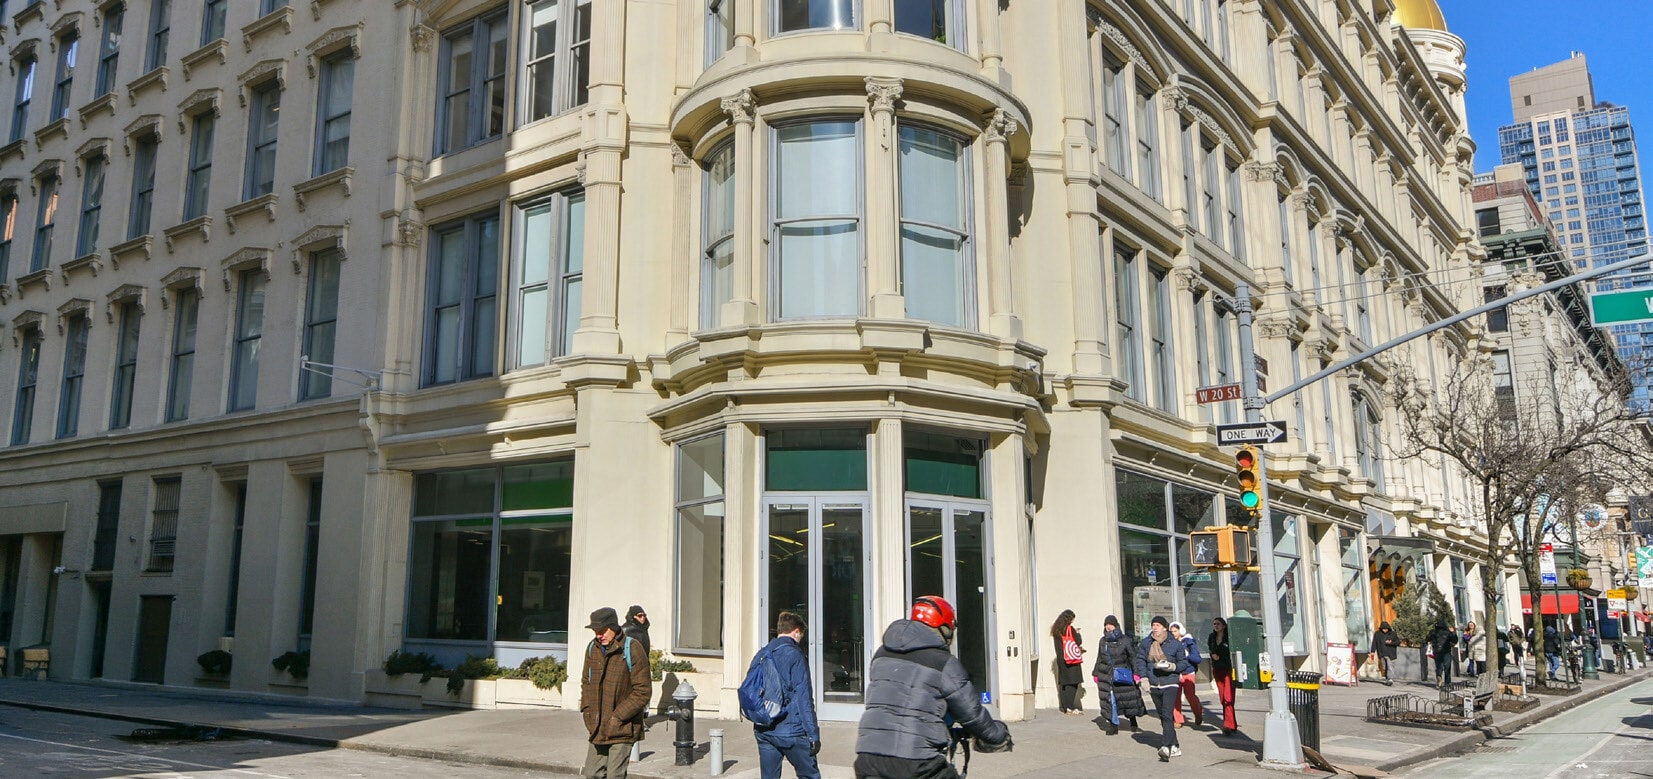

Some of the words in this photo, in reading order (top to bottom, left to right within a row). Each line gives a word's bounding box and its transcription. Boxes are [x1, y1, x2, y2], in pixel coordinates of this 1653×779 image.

[1199, 391, 1208, 402] W
[1211, 389, 1223, 400] 20
[1227, 387, 1237, 398] St
[1226, 430, 1246, 440] ONE
[1255, 428, 1276, 437] WAY
